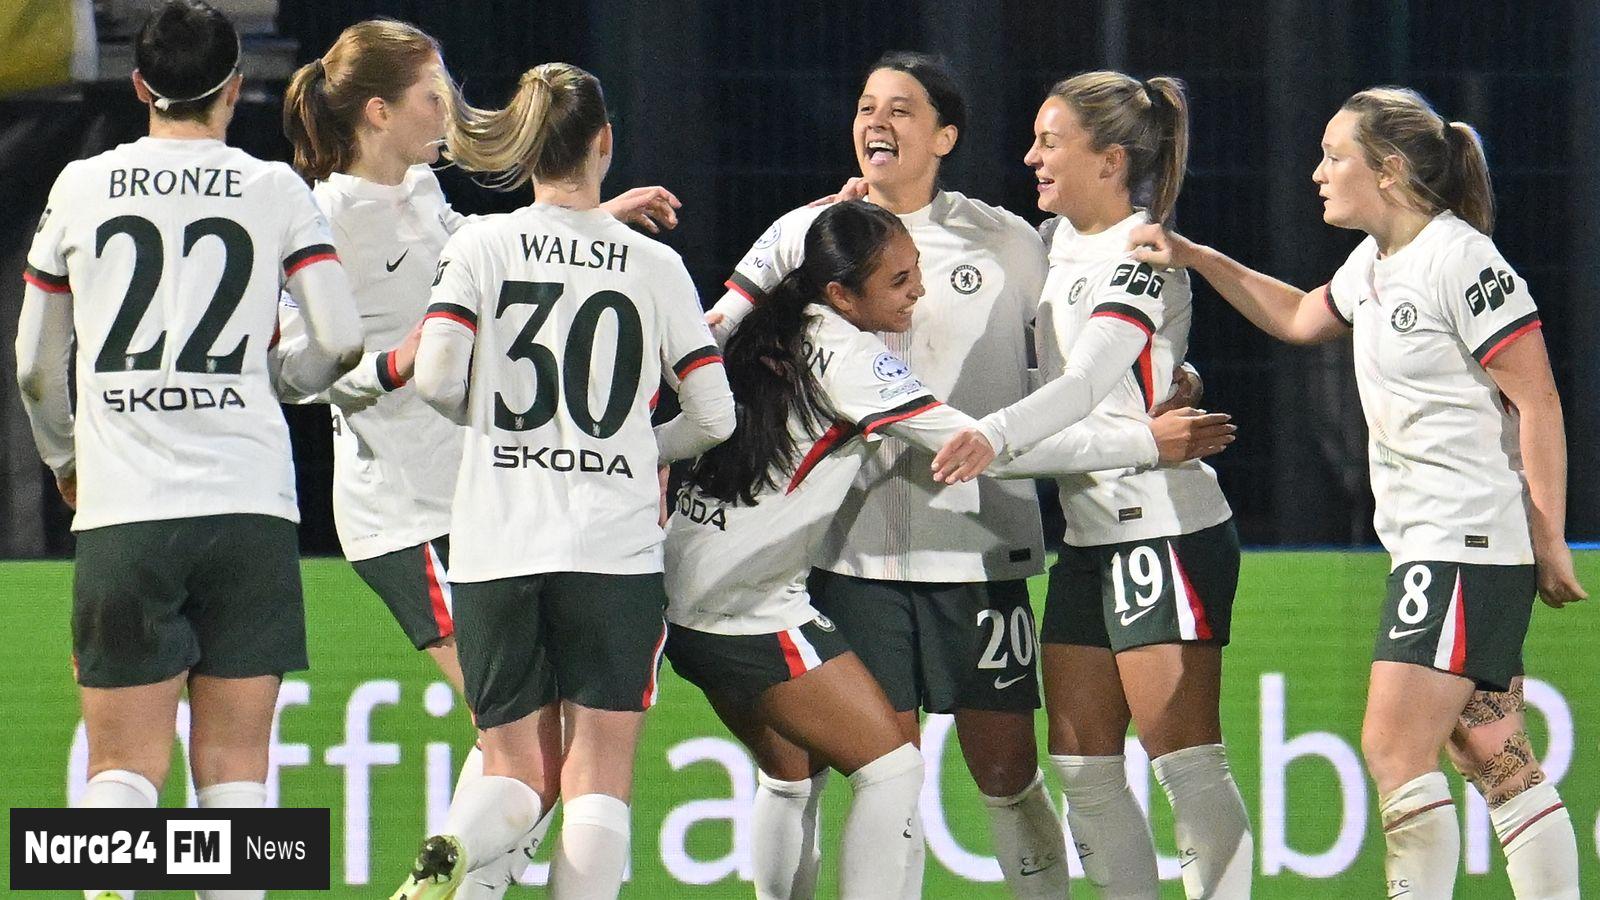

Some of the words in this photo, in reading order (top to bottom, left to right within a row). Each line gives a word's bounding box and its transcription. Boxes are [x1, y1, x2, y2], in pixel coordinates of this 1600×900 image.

[109, 167, 243, 198] BRONZE
[520, 233, 629, 273] WALSH
[95, 214, 255, 374] 22
[1111, 266, 1163, 295] FPT
[1467, 270, 1513, 312] FPT
[494, 280, 644, 439] 30
[1111, 545, 1163, 614] 19
[1397, 564, 1432, 624] 8
[976, 606, 1032, 669] 20
[1386, 879, 1409, 889] FC
